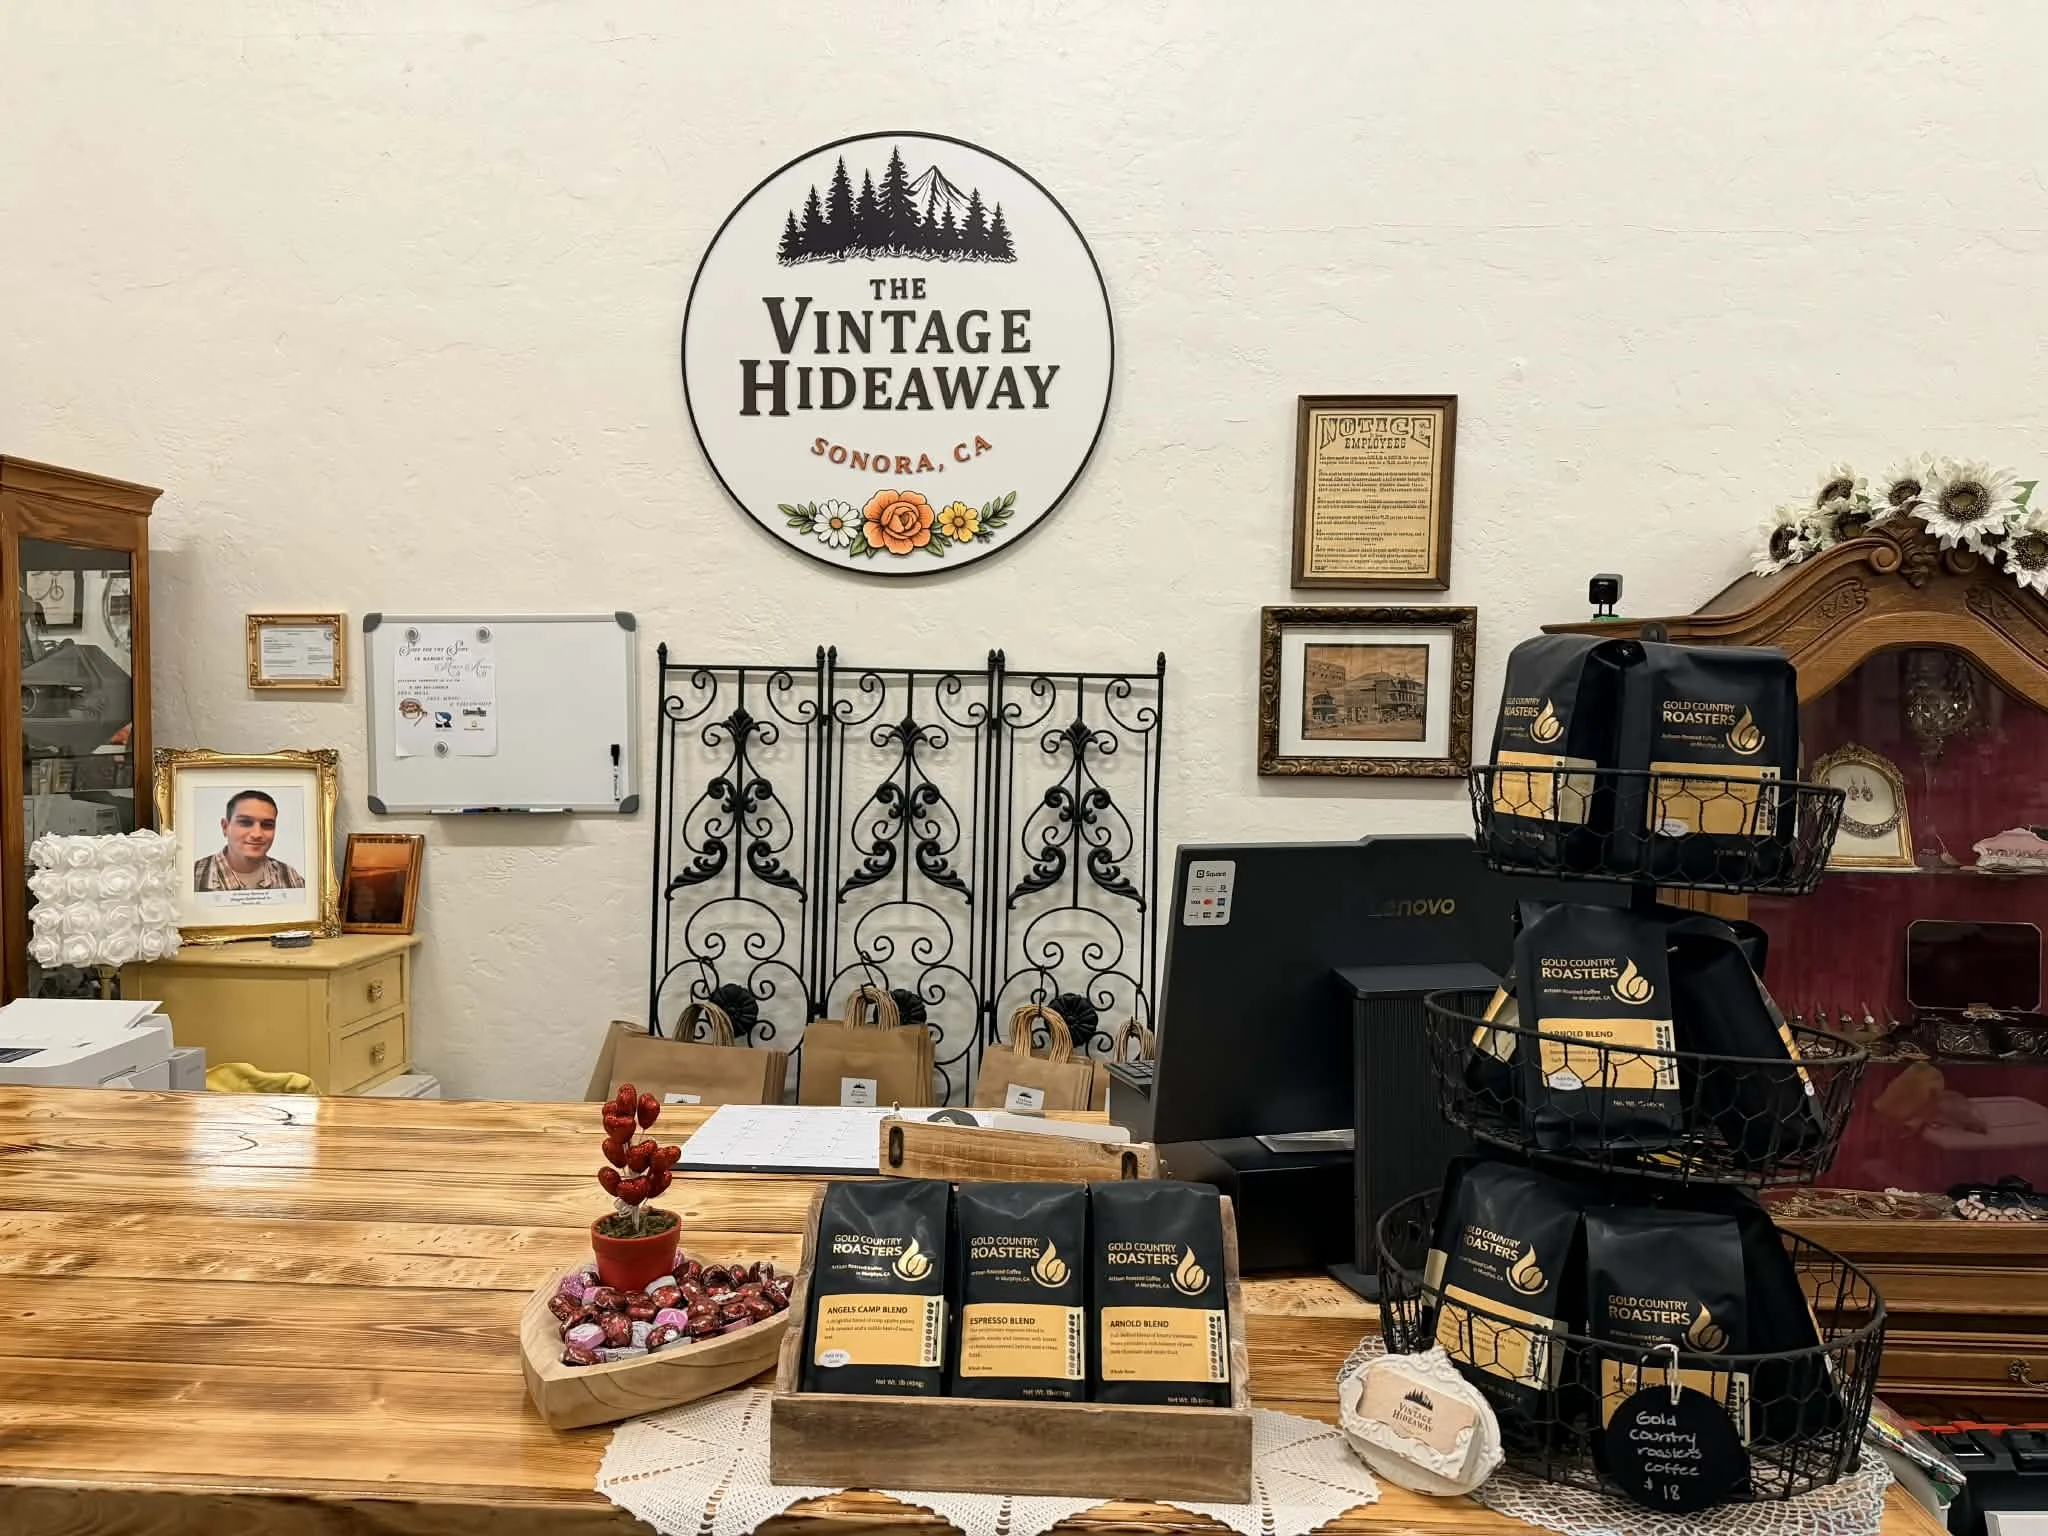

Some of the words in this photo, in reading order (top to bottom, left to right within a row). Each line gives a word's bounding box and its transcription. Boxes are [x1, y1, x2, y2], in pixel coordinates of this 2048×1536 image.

[870, 278, 926, 299] THE
[762, 297, 1032, 354] VINTAGE
[739, 360, 1060, 416] HIDEAWAY
[1320, 417, 1431, 449] NOTICE
[1345, 438, 1406, 449] EMPLOYEES
[811, 437, 946, 475] SONORA,
[953, 434, 993, 462] CA
[1663, 700, 1691, 710] GOLD
[1692, 702, 1735, 713] COUNTRY
[1663, 711, 1736, 726] ROASTERS
[1541, 959, 1567, 967] GOLD
[1569, 958, 1615, 967] COUNTRY
[1542, 967, 1619, 979] ROASTERS
[1585, 1030, 1613, 1038] BLEND
[835, 1234, 859, 1243] GOLD
[860, 1235, 902, 1245] COUNTRY
[971, 1236, 994, 1246] GOLD
[996, 1236, 1038, 1246] COUNTRY
[1482, 1230, 1521, 1248] COUNTRY
[833, 1243, 902, 1256] ROASTERS
[971, 1247, 1040, 1259] ROASTERS
[1108, 1242, 1132, 1251] GOLD
[1134, 1242, 1176, 1253] COUNTRY
[1108, 1253, 1178, 1265] ROASTERS
[1608, 1294, 1637, 1307] GOLD
[1638, 1298, 1688, 1311] COUNTRY
[827, 1306, 856, 1314] ANGELS
[882, 1306, 908, 1314] BLEND
[1609, 1305, 1691, 1325] ROASTERS
[969, 1316, 1008, 1325] ESPRESSO
[1009, 1317, 1036, 1325] BLEND
[1110, 1320, 1142, 1328] ARNOLD
[1143, 1320, 1169, 1328] BLEND
[1399, 1402, 1433, 1425] VINTAGE
[1636, 1410, 1677, 1426] Gold
[1392, 1409, 1433, 1433] HIDEAWAY
[1644, 1462, 1700, 1476] coffee
[1663, 1484, 1681, 1501] 18
